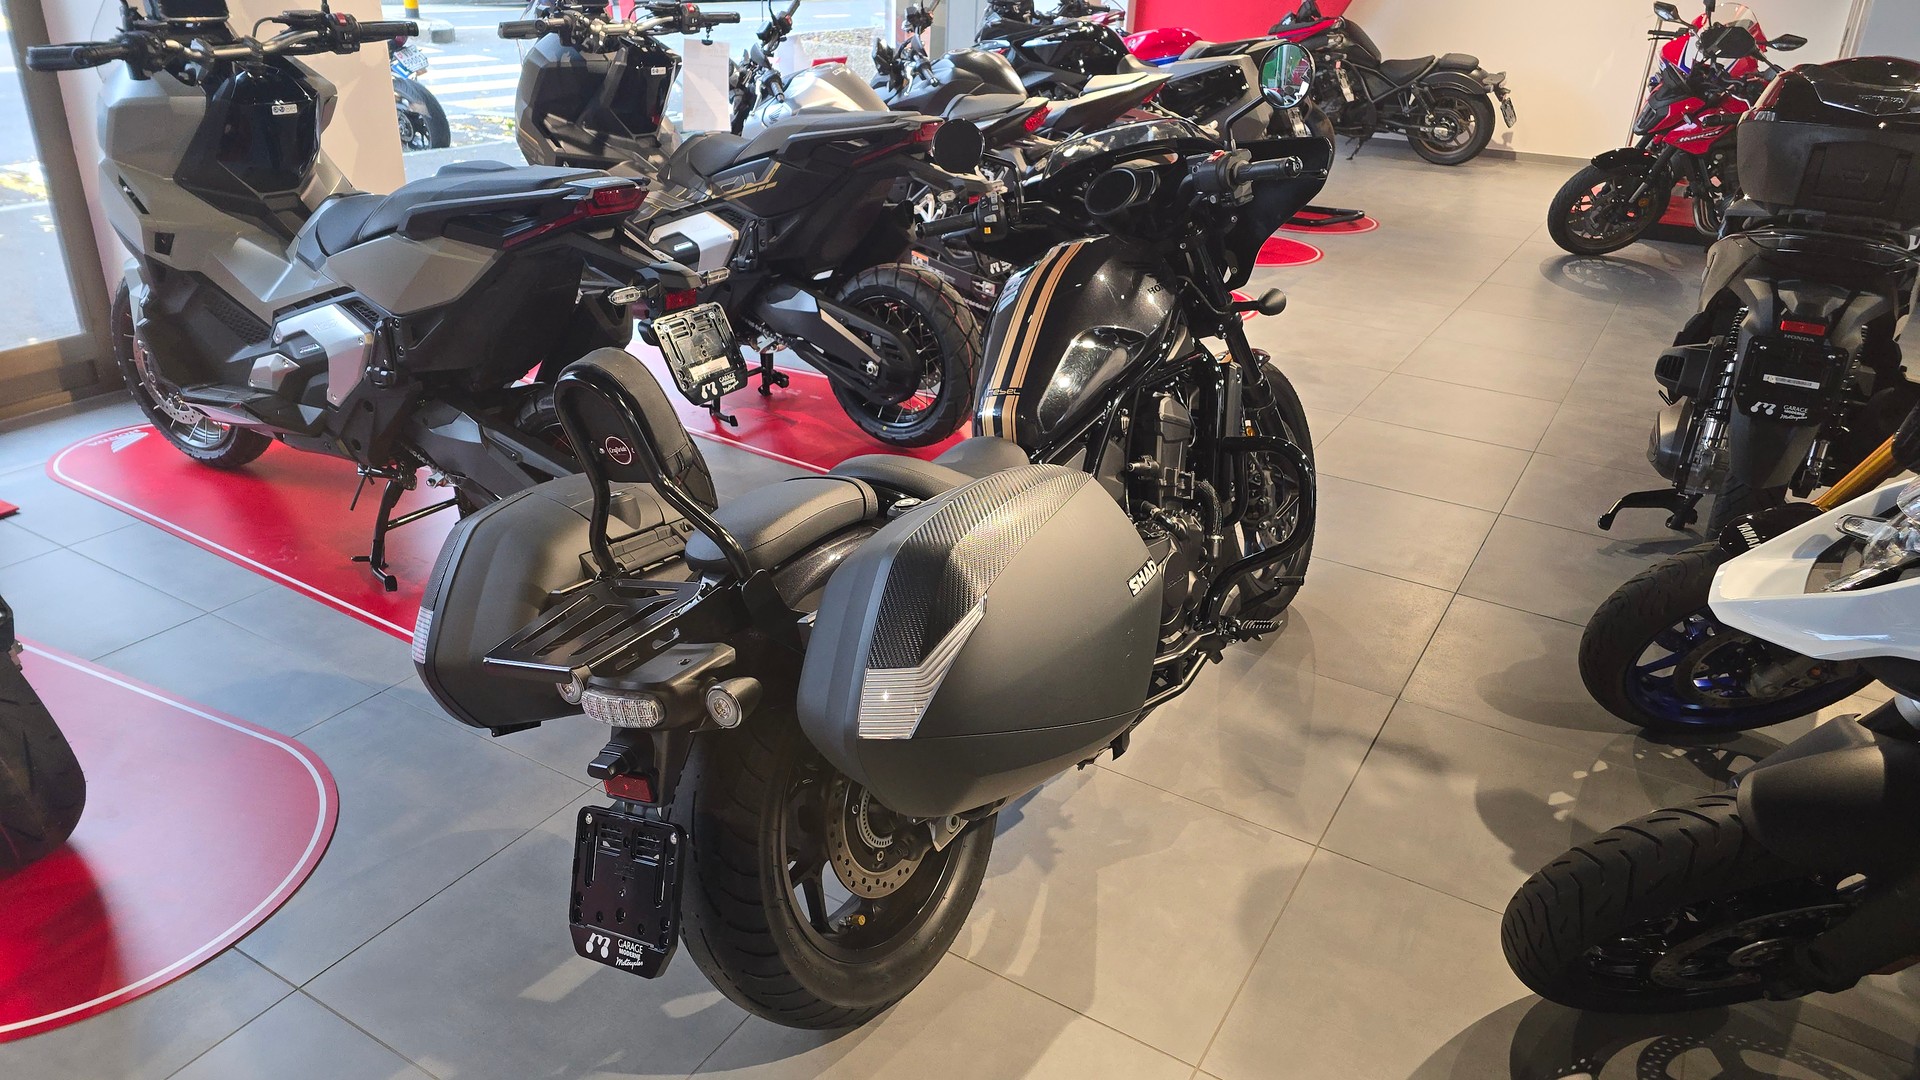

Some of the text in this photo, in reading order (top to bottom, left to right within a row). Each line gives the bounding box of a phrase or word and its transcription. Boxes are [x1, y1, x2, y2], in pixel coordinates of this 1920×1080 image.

[1784, 334, 1815, 343] HONDA
[1783, 404, 1808, 413] GARAGE
[1128, 559, 1157, 596] SHAD
[617, 938, 643, 955] GARAGE
[618, 947, 641, 961] MODERNE
